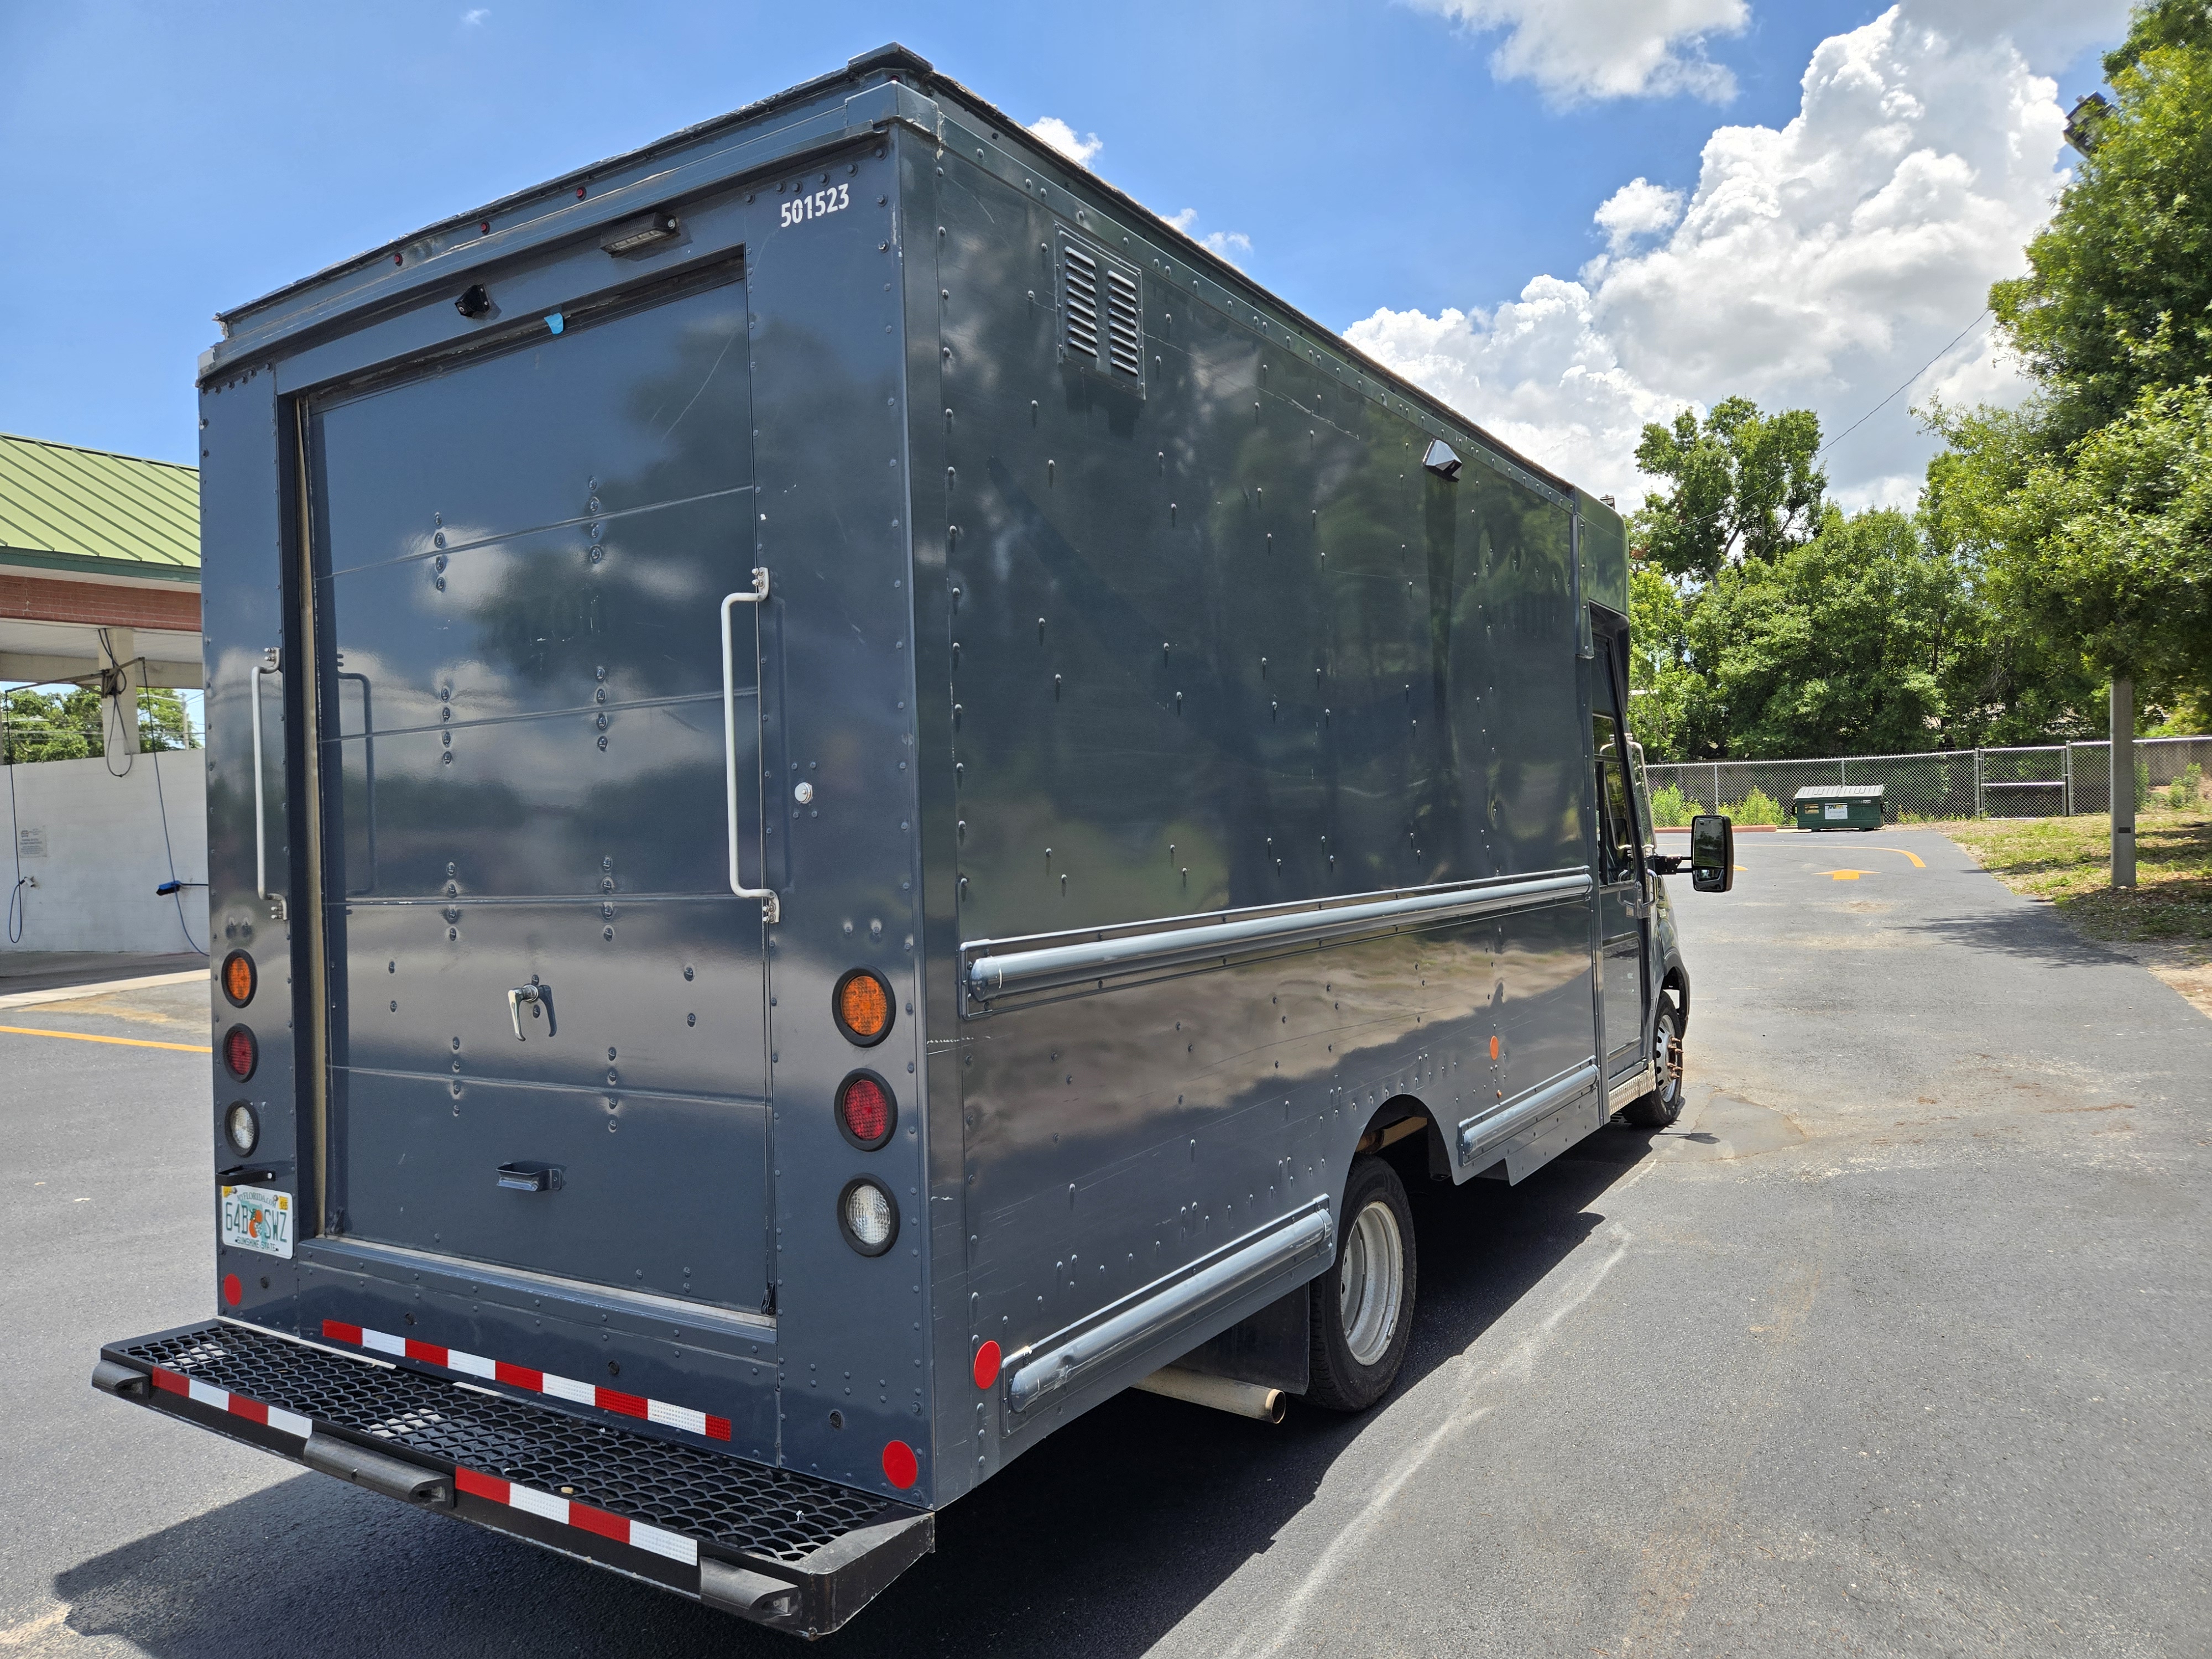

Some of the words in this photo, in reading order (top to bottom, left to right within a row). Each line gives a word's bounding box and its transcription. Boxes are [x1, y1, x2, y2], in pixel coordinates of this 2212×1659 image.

[781, 183, 849, 227] 501523
[226, 1202, 248, 1234] 64B
[264, 1209, 288, 1243] SWZ
[237, 1237, 259, 1249] SUNSHINE
[261, 1241, 276, 1251] STATE
